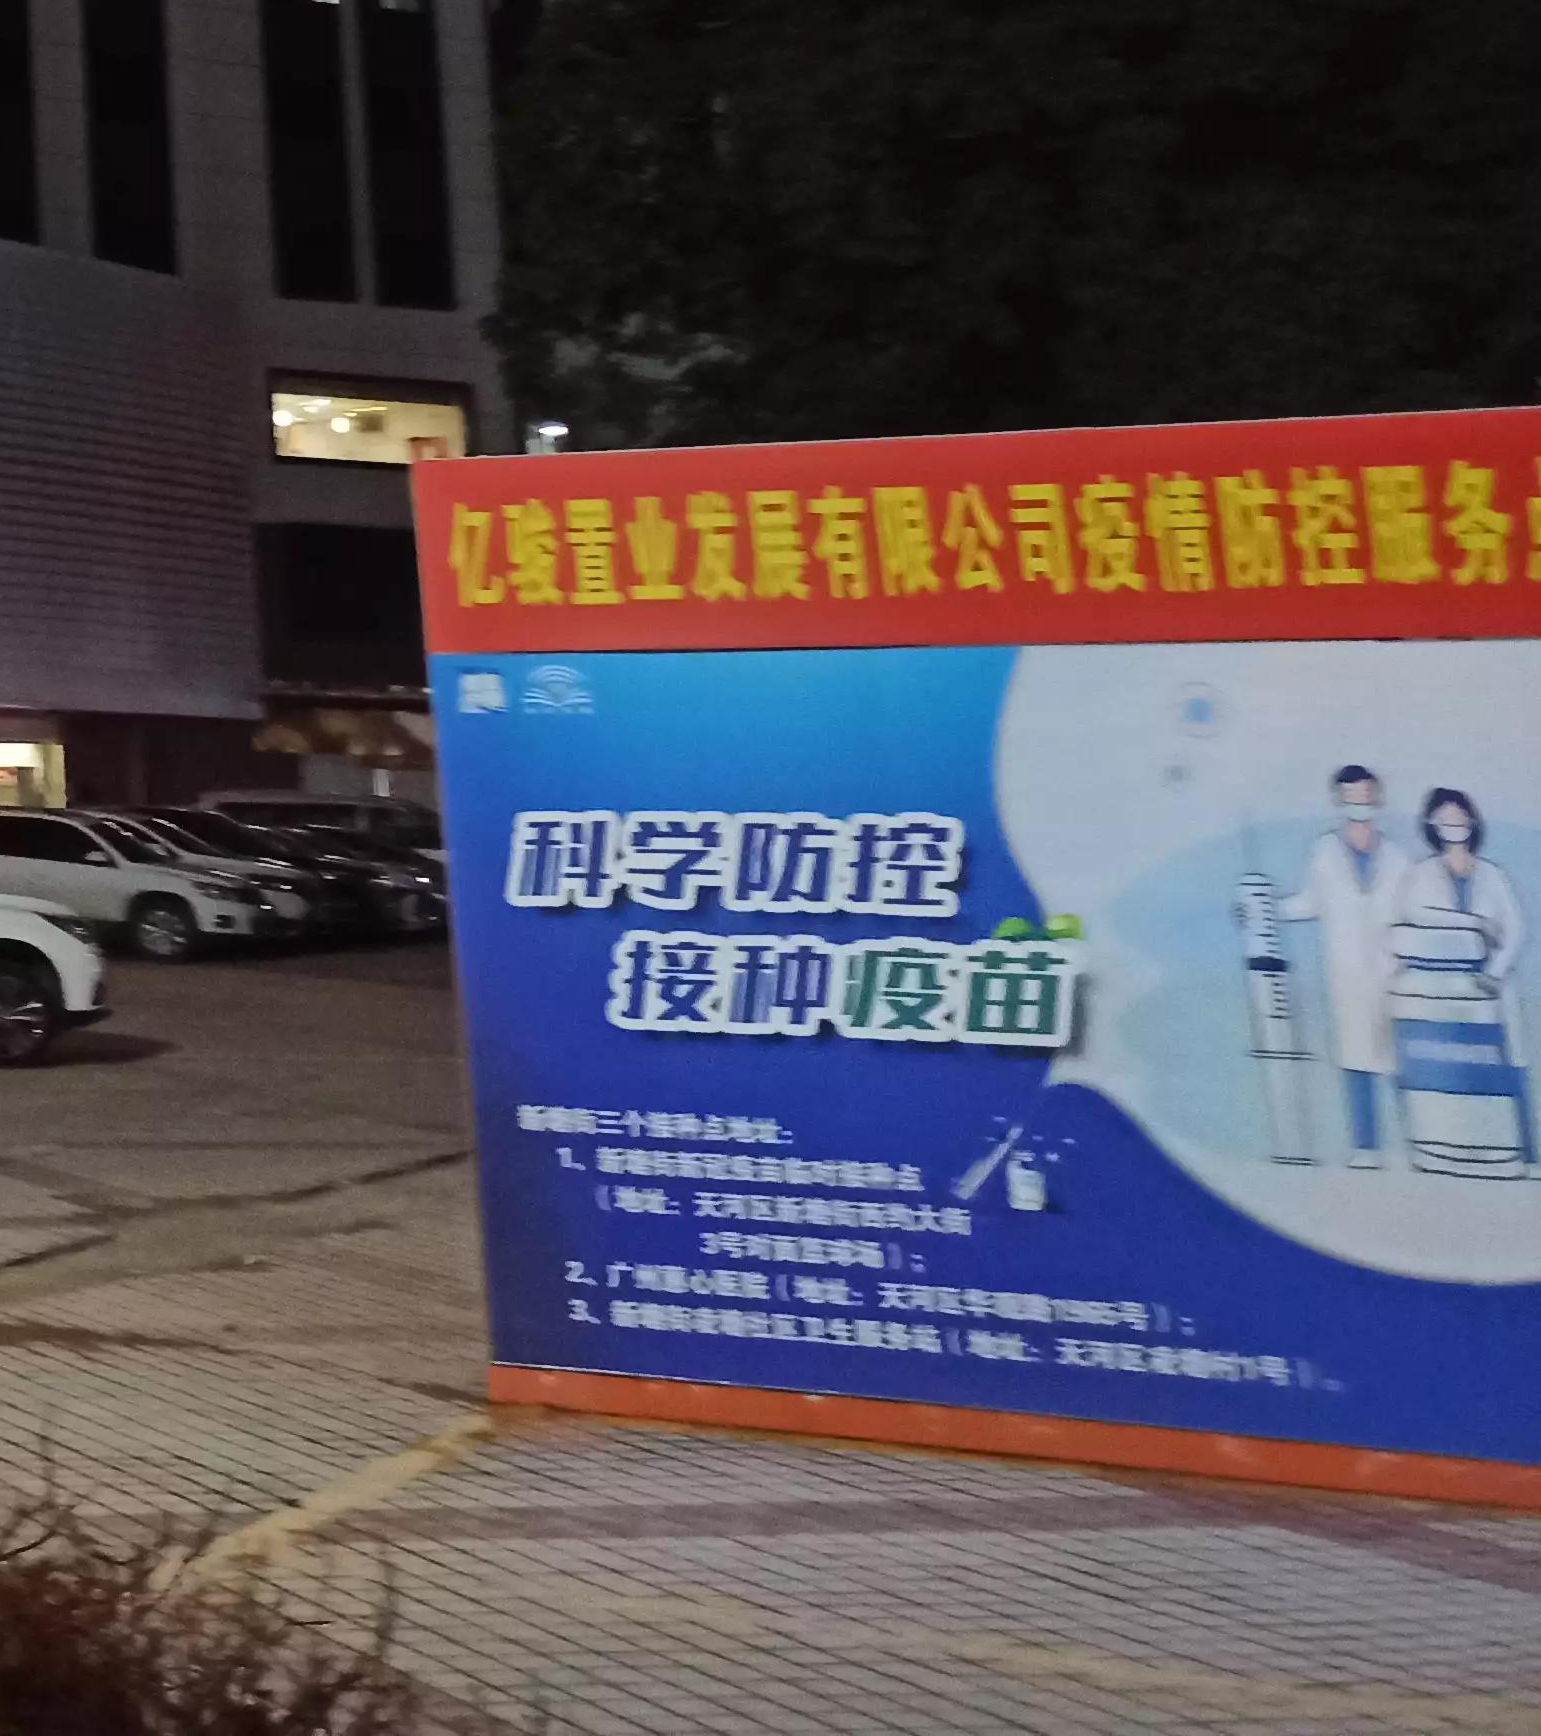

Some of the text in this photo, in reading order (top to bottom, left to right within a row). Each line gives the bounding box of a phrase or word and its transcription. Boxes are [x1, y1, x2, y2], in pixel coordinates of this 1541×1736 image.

[511, 812, 960, 915] 科学防控
[612, 930, 1075, 1047] 接种疫苗
